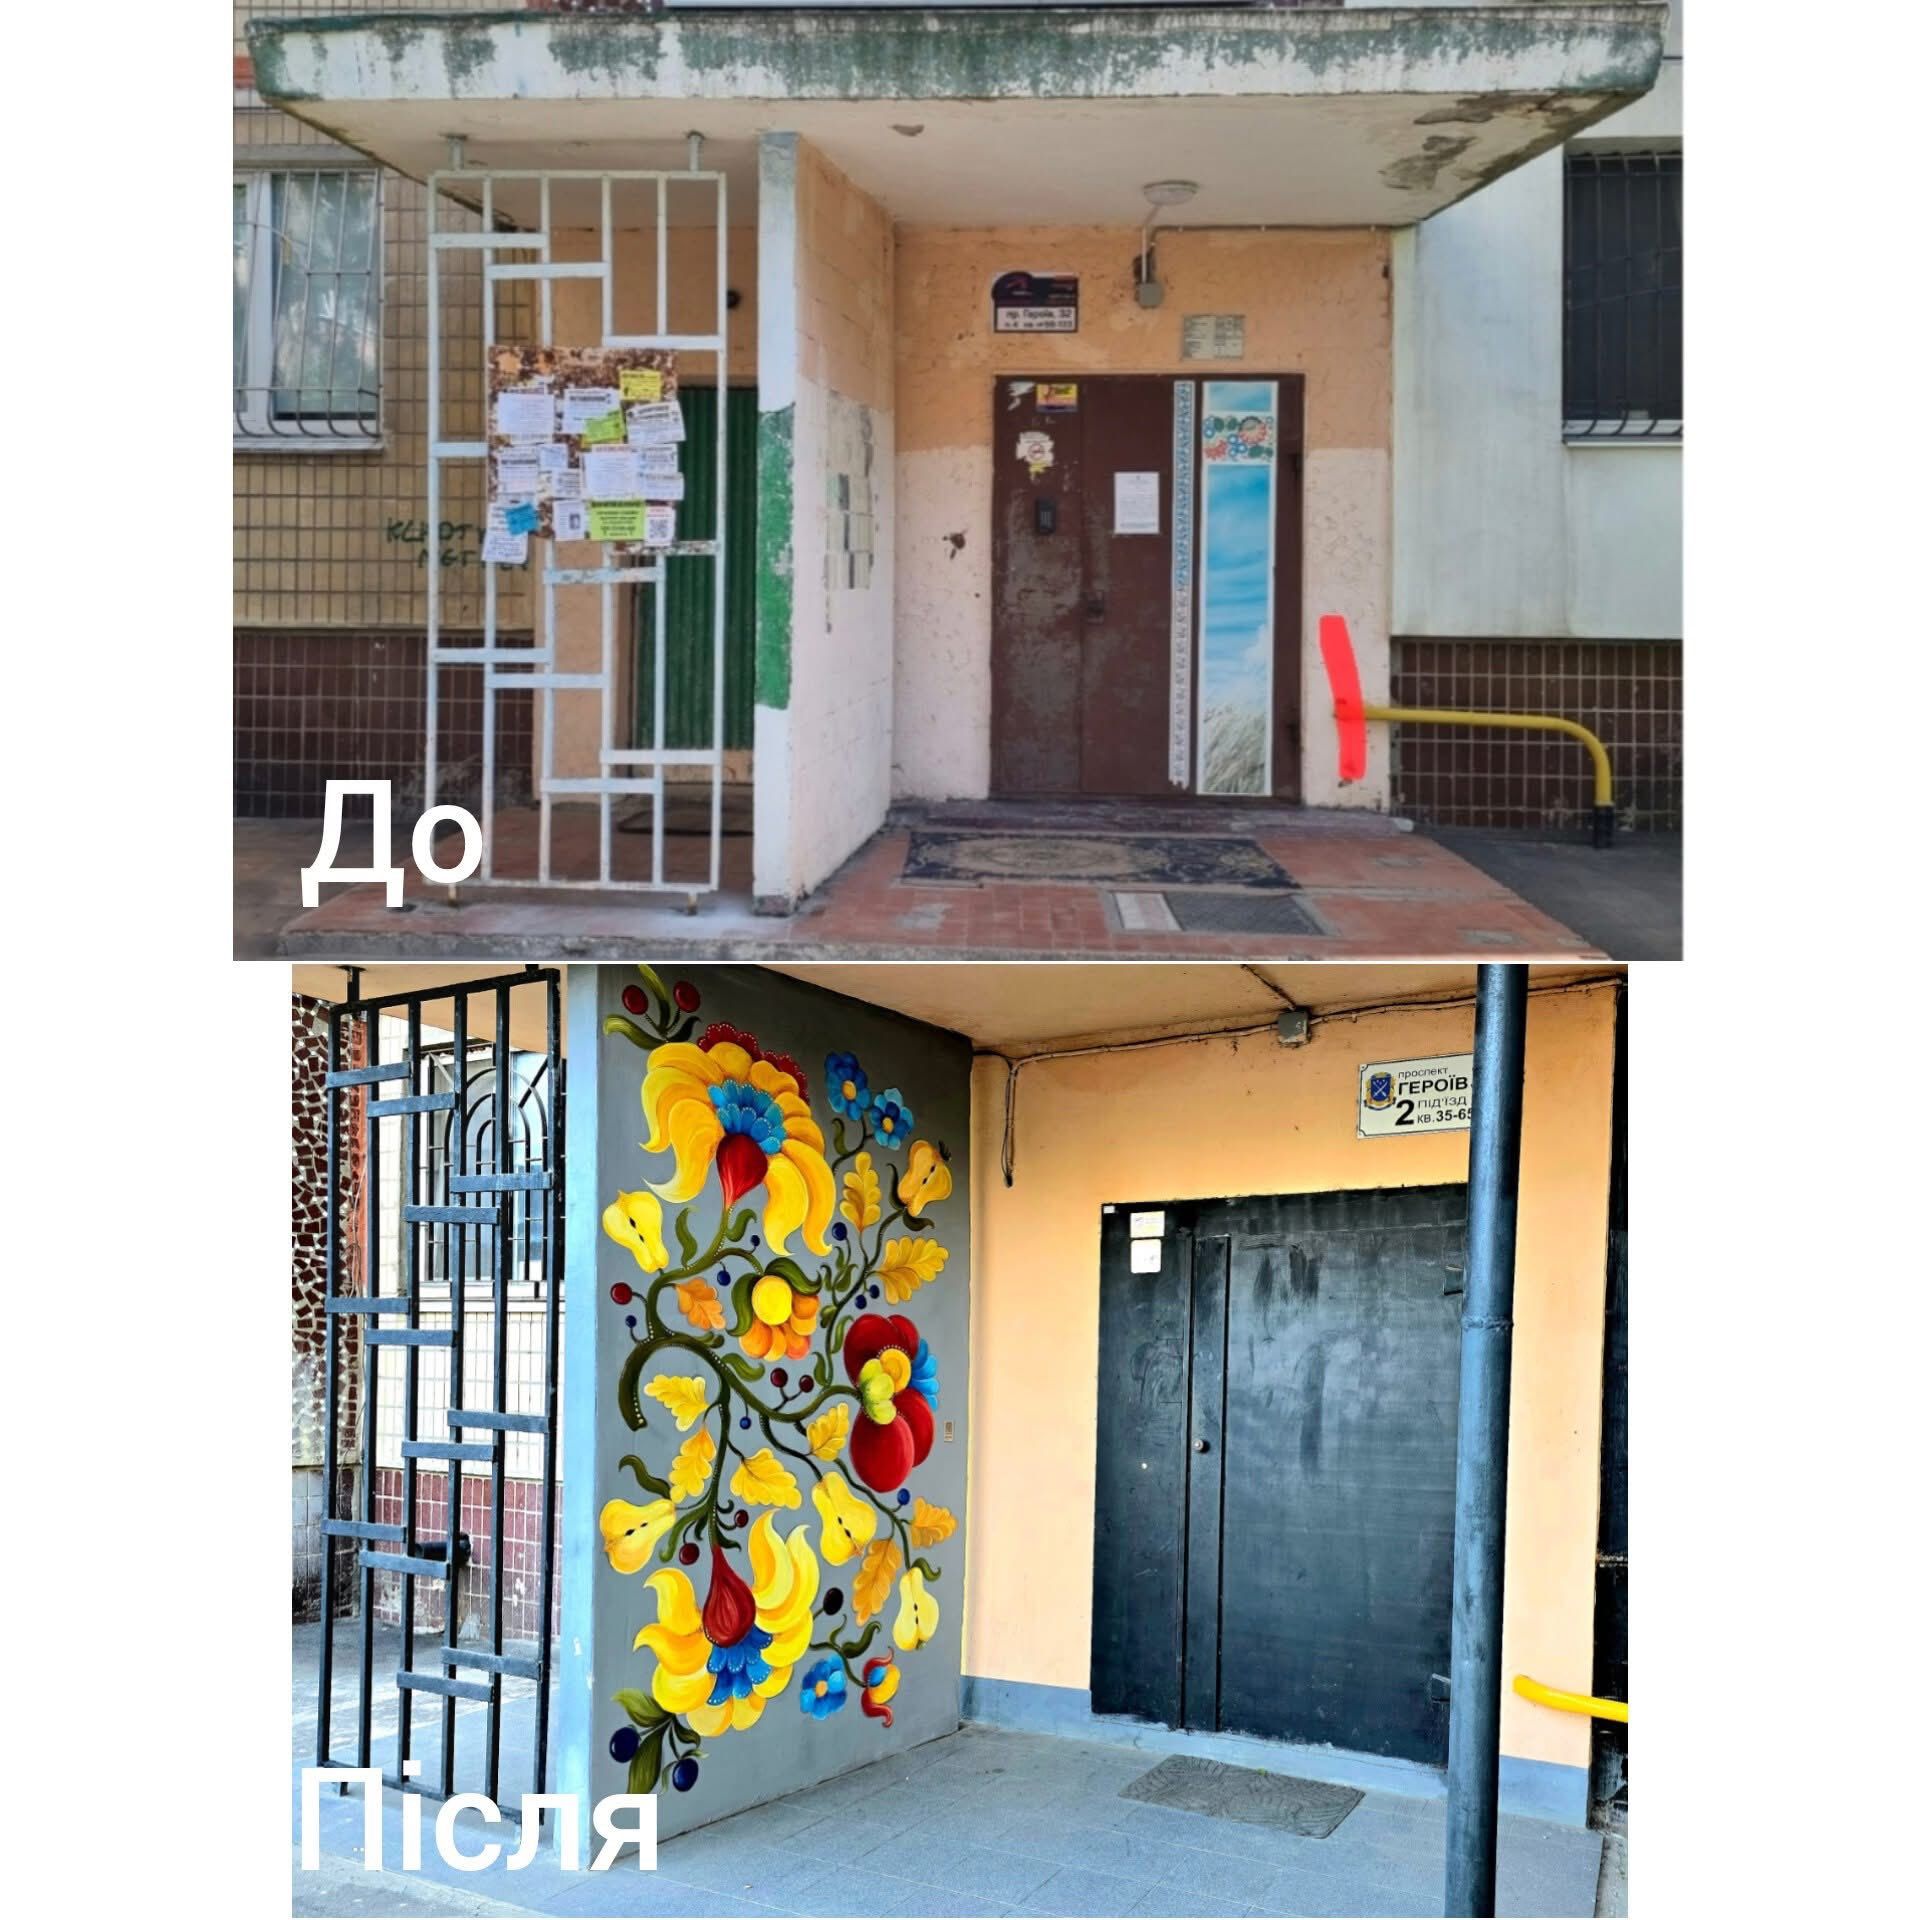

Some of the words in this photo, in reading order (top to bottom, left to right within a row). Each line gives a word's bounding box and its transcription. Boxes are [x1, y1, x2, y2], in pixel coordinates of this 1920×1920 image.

[1398, 1067, 1448, 1080] проспект
[1398, 1074, 1468, 1096] ГЕРОЇВ
[1395, 1099, 1415, 1126] 2
